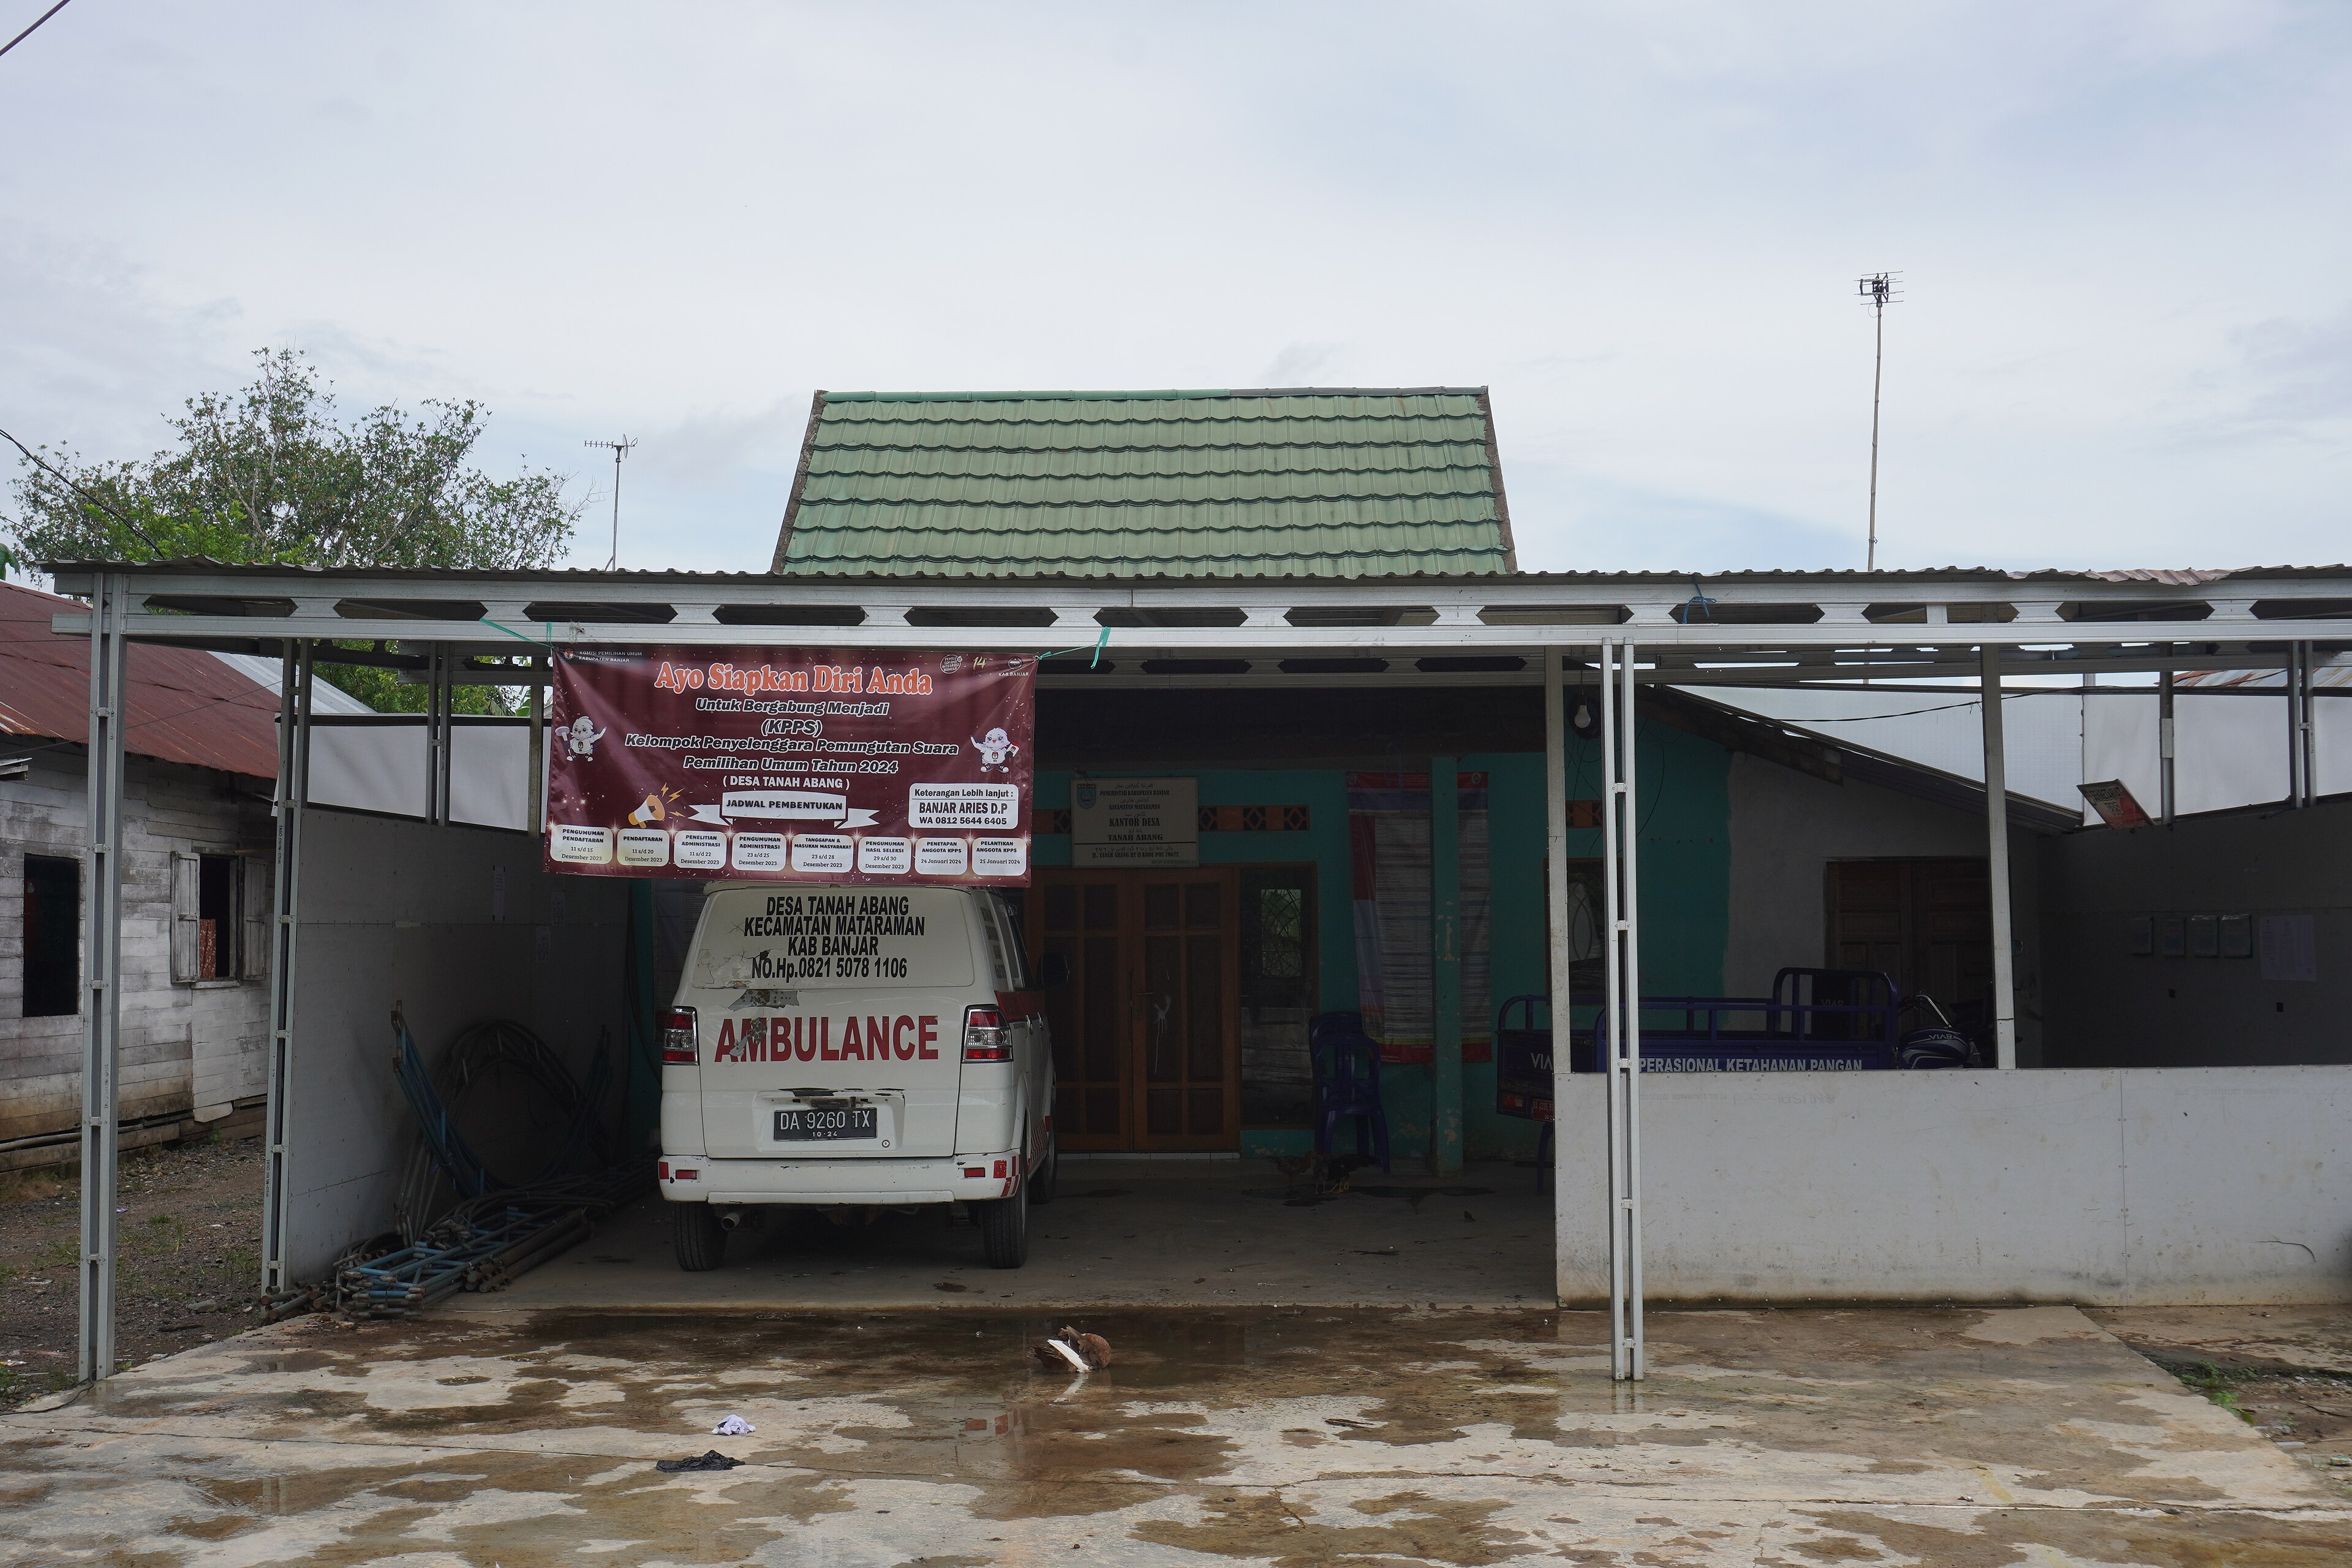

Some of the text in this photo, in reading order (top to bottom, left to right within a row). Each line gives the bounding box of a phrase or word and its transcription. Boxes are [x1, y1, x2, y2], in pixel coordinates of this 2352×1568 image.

[654, 662, 933, 696] Ayo Siapkan Diri Anda
[695, 698, 890, 717] Untuk Bergabung Menjadi
[761, 718, 823, 737] (KPPS)
[625, 734, 959, 755] Kelompok Penyelenggara Pemungutan Suara
[683, 755, 899, 774] Pemilihan Umum Tahun 2024
[730, 776, 760, 786] DESA
[763, 776, 800, 787] TANAH
[802, 777, 843, 788] ABANG
[914, 789, 960, 798] Keterangan
[726, 799, 843, 810] JADWAL PEMBENTUKAN
[919, 802, 1008, 814] BANJAR ARIES D.P
[1109, 818, 1160, 827] KANTOR DESA
[766, 896, 910, 916] DESA TANAH ABANG
[744, 916, 925, 937] KECAMATAN MATARAMAN
[788, 936, 878, 956] KAB BANJAR
[835, 957, 870, 978] 5078
[874, 957, 908, 978] 1106
[714, 1015, 939, 1063] AMBULANCE
[1530, 1053, 1553, 1071] VIA
[1639, 1058, 1862, 1072] PERASIONAL KETAHANAN PANGAN
[780, 1110, 870, 1130] DA 9260 TX
